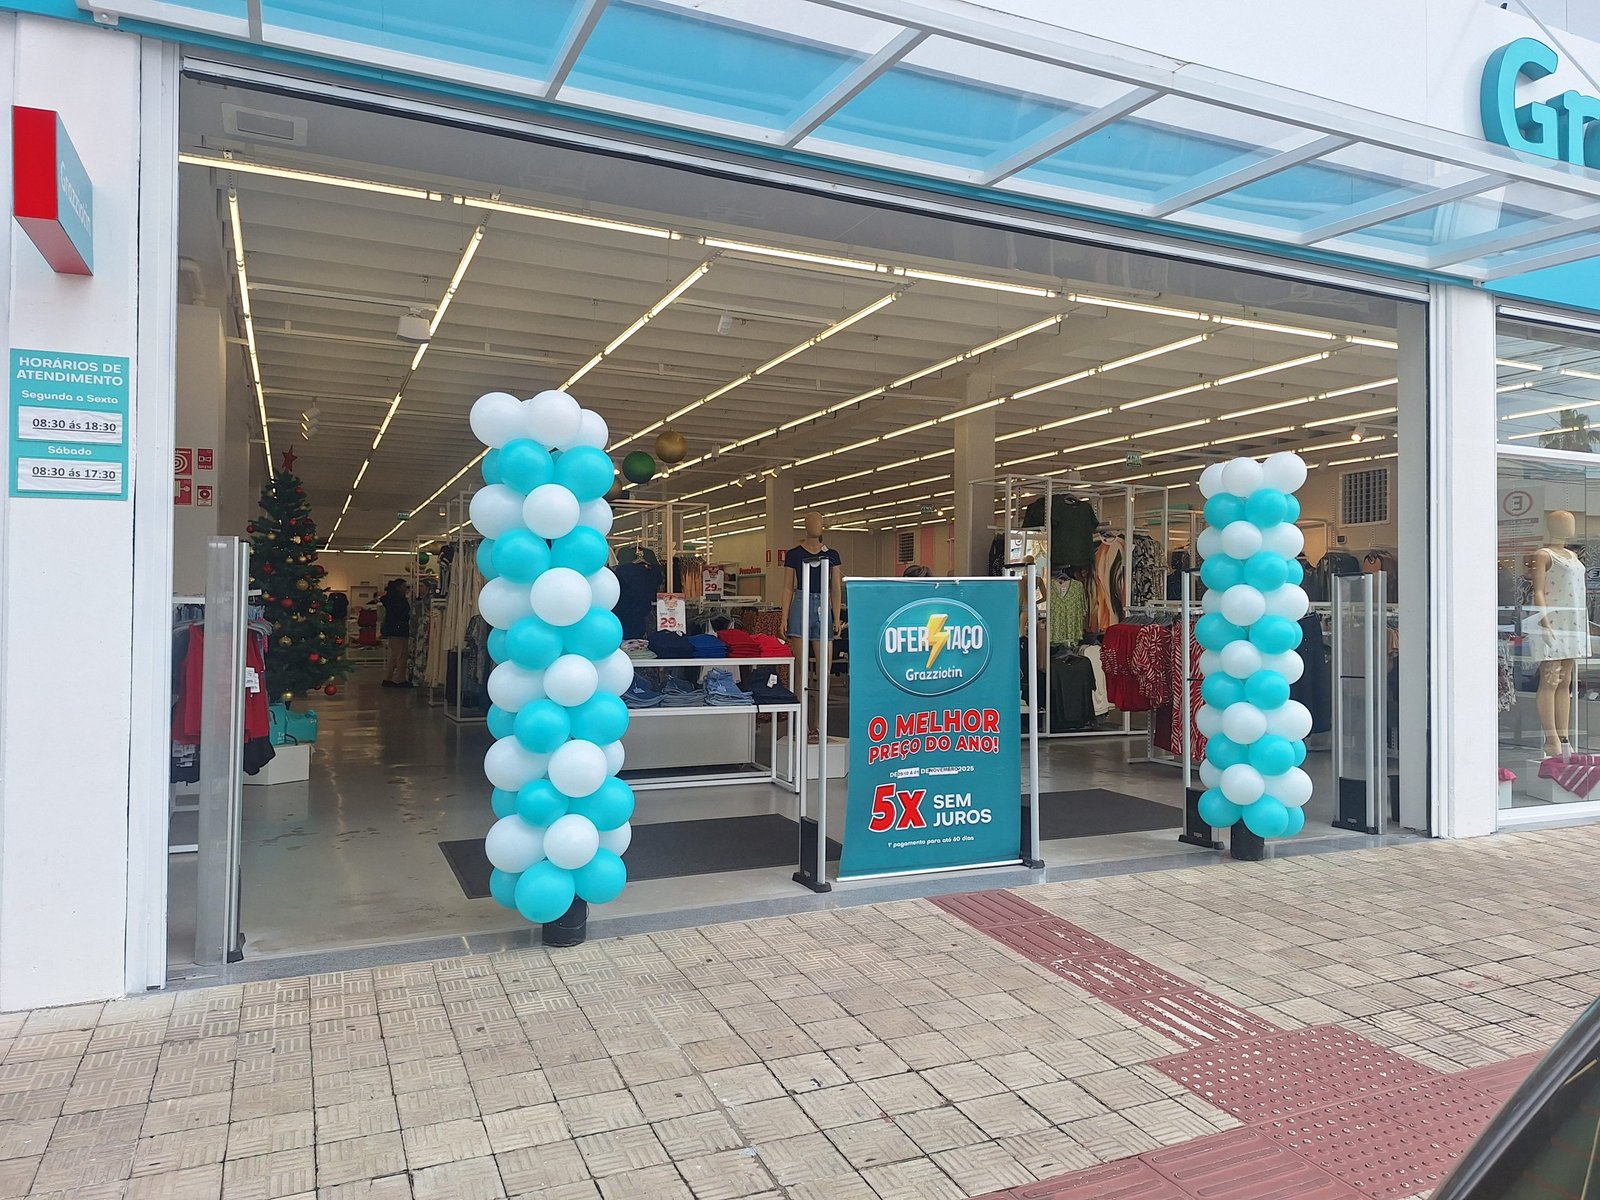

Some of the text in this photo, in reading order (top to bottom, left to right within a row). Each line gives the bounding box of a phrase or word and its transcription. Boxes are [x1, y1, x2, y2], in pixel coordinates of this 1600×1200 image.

[1480, 37, 1600, 168] Gr
[60, 160, 91, 237] Grazziotin
[19, 357, 121, 373] HORÁRIOS DE
[17, 370, 123, 386] ATENDIMENTO
[21, 390, 73, 401] Segunda
[87, 394, 118, 404] Sexta
[32, 418, 66, 429] 08:30
[85, 422, 116, 432] 18:30
[48, 445, 92, 456] Sábado
[32, 466, 65, 477] 08:30
[84, 469, 116, 479] 17:30
[905, 666, 963, 682] Grazziotin
[868, 708, 1000, 742] O MELHOR
[868, 735, 1000, 764] PREÇO DO ANO!
[868, 783, 927, 833] 5X
[933, 793, 972, 809] SEM
[933, 809, 992, 827] JUROS
[893, 840, 926, 849] pagamento
